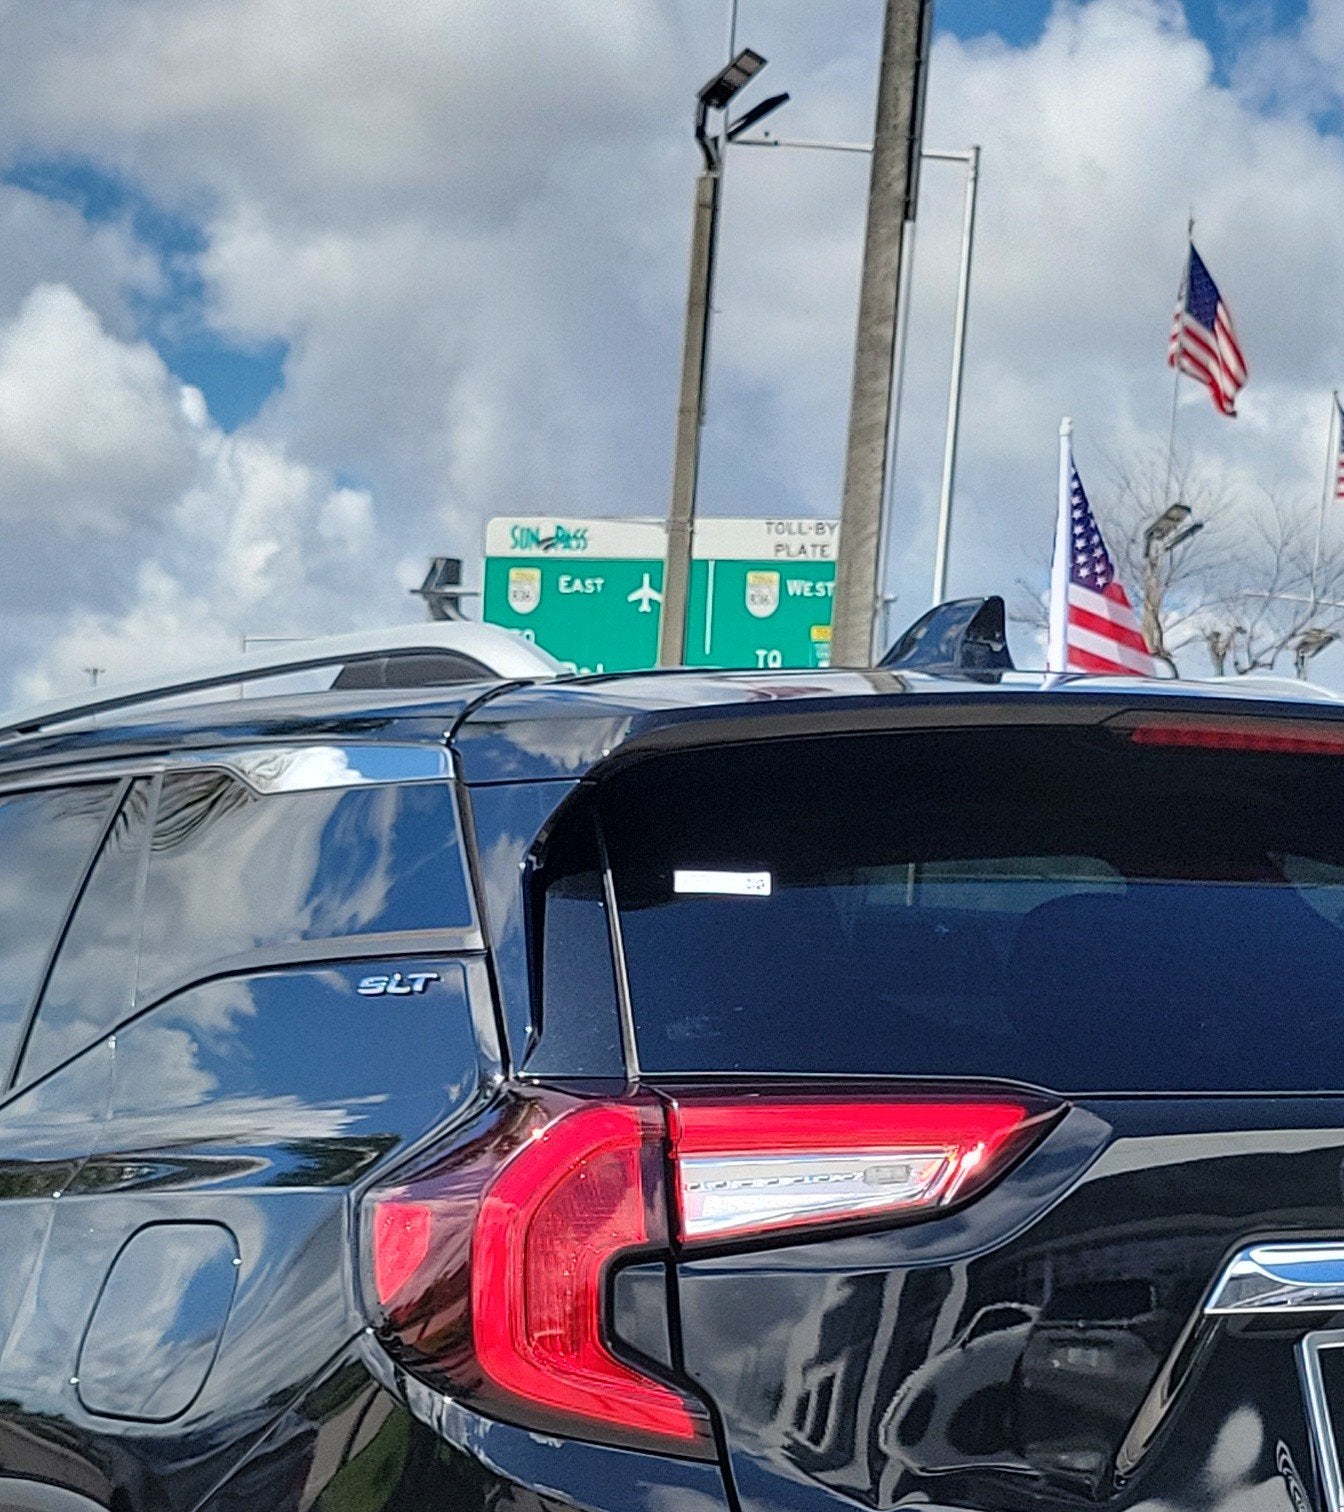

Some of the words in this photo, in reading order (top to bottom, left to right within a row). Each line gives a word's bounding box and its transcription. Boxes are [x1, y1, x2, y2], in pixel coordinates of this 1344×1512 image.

[774, 543, 831, 559] PLATE
[558, 574, 605, 594] EAST
[786, 578, 836, 598] WEST
[755, 649, 783, 669] TO
[356, 972, 439, 996] SLT
